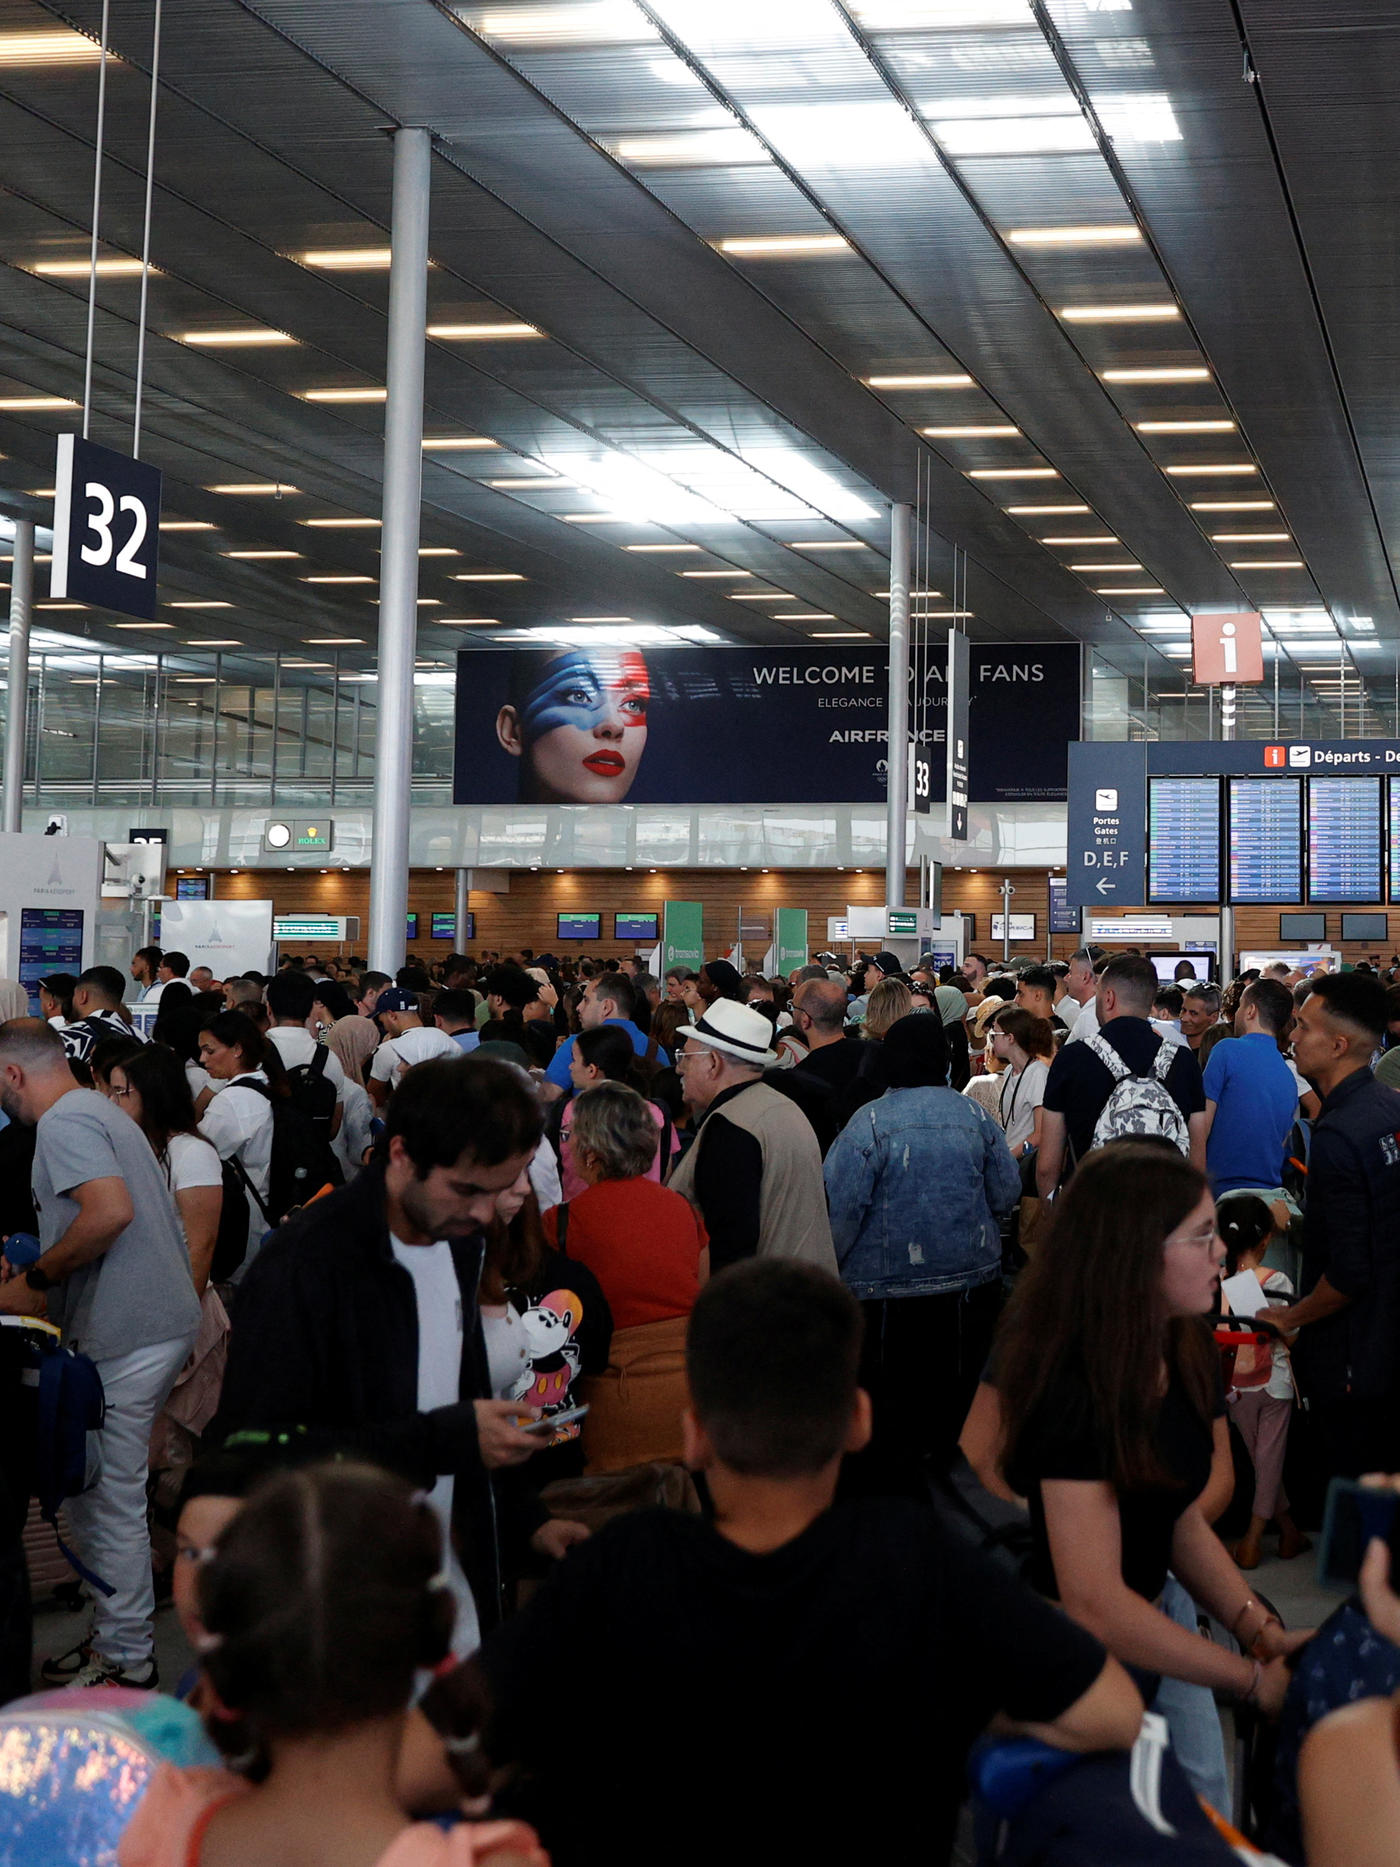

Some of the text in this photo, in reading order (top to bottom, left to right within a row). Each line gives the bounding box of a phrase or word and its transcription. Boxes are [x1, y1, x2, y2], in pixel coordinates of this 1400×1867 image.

[80, 481, 148, 579] 32
[753, 665, 875, 684] WELCOME
[980, 664, 1044, 682] FANS
[817, 697, 883, 708] ELEGANCE
[828, 729, 946, 743] AIRFRNCE
[1314, 749, 1371, 766] Départs
[916, 760, 930, 798] 33
[1093, 817, 1120, 826] Portes
[1094, 827, 1119, 836] Gates
[1083, 851, 1129, 869] D,E,F
